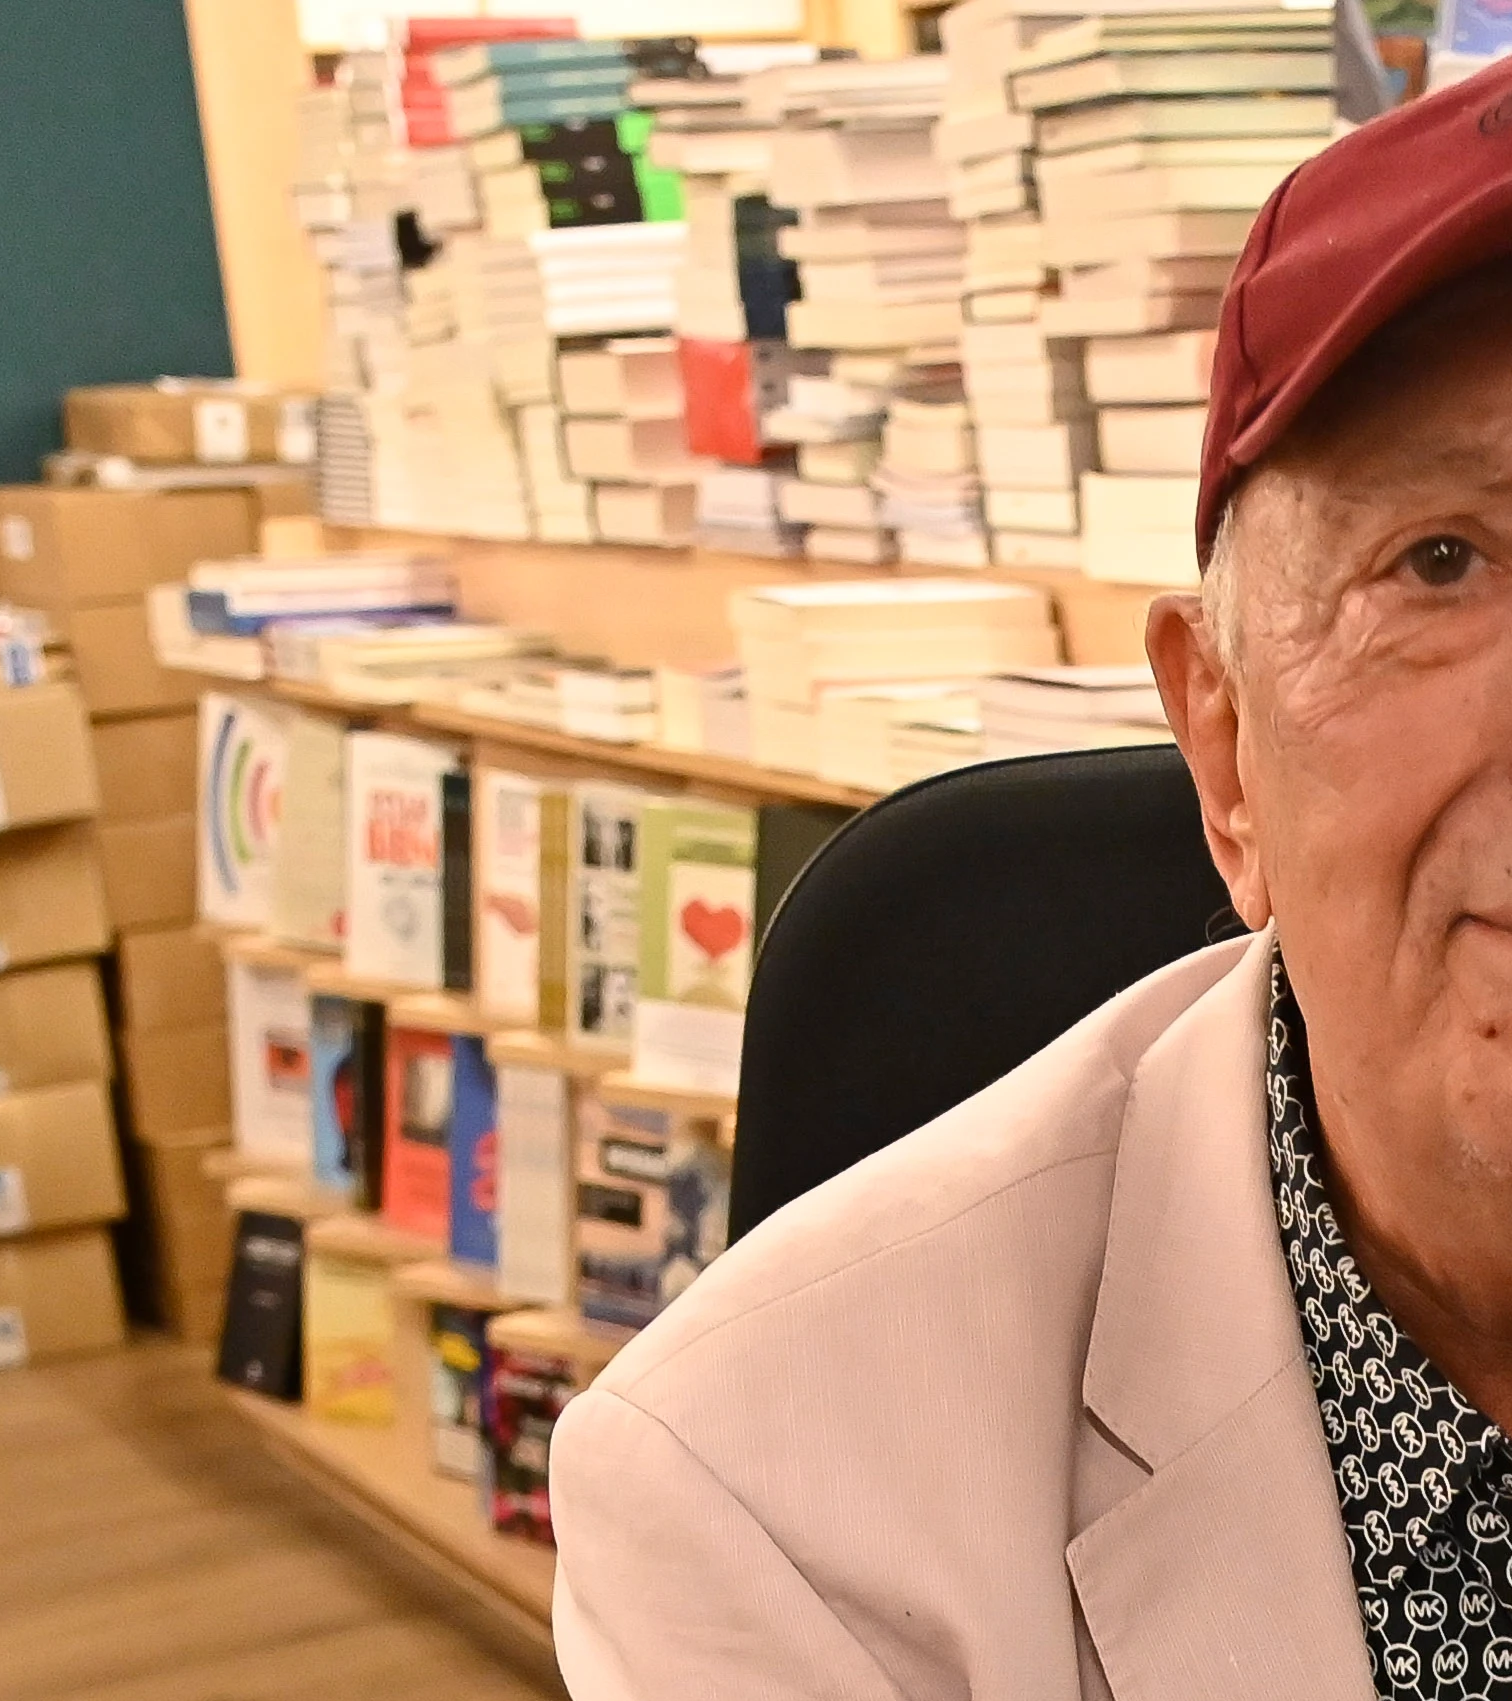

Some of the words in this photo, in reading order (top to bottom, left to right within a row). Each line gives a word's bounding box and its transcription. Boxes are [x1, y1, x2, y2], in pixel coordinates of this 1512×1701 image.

[1470, 1508, 1506, 1532] MK
[1407, 1596, 1443, 1620] MK
[1461, 1593, 1489, 1614] MK
[1384, 1653, 1417, 1677] MK
[1437, 1650, 1463, 1673] MK
